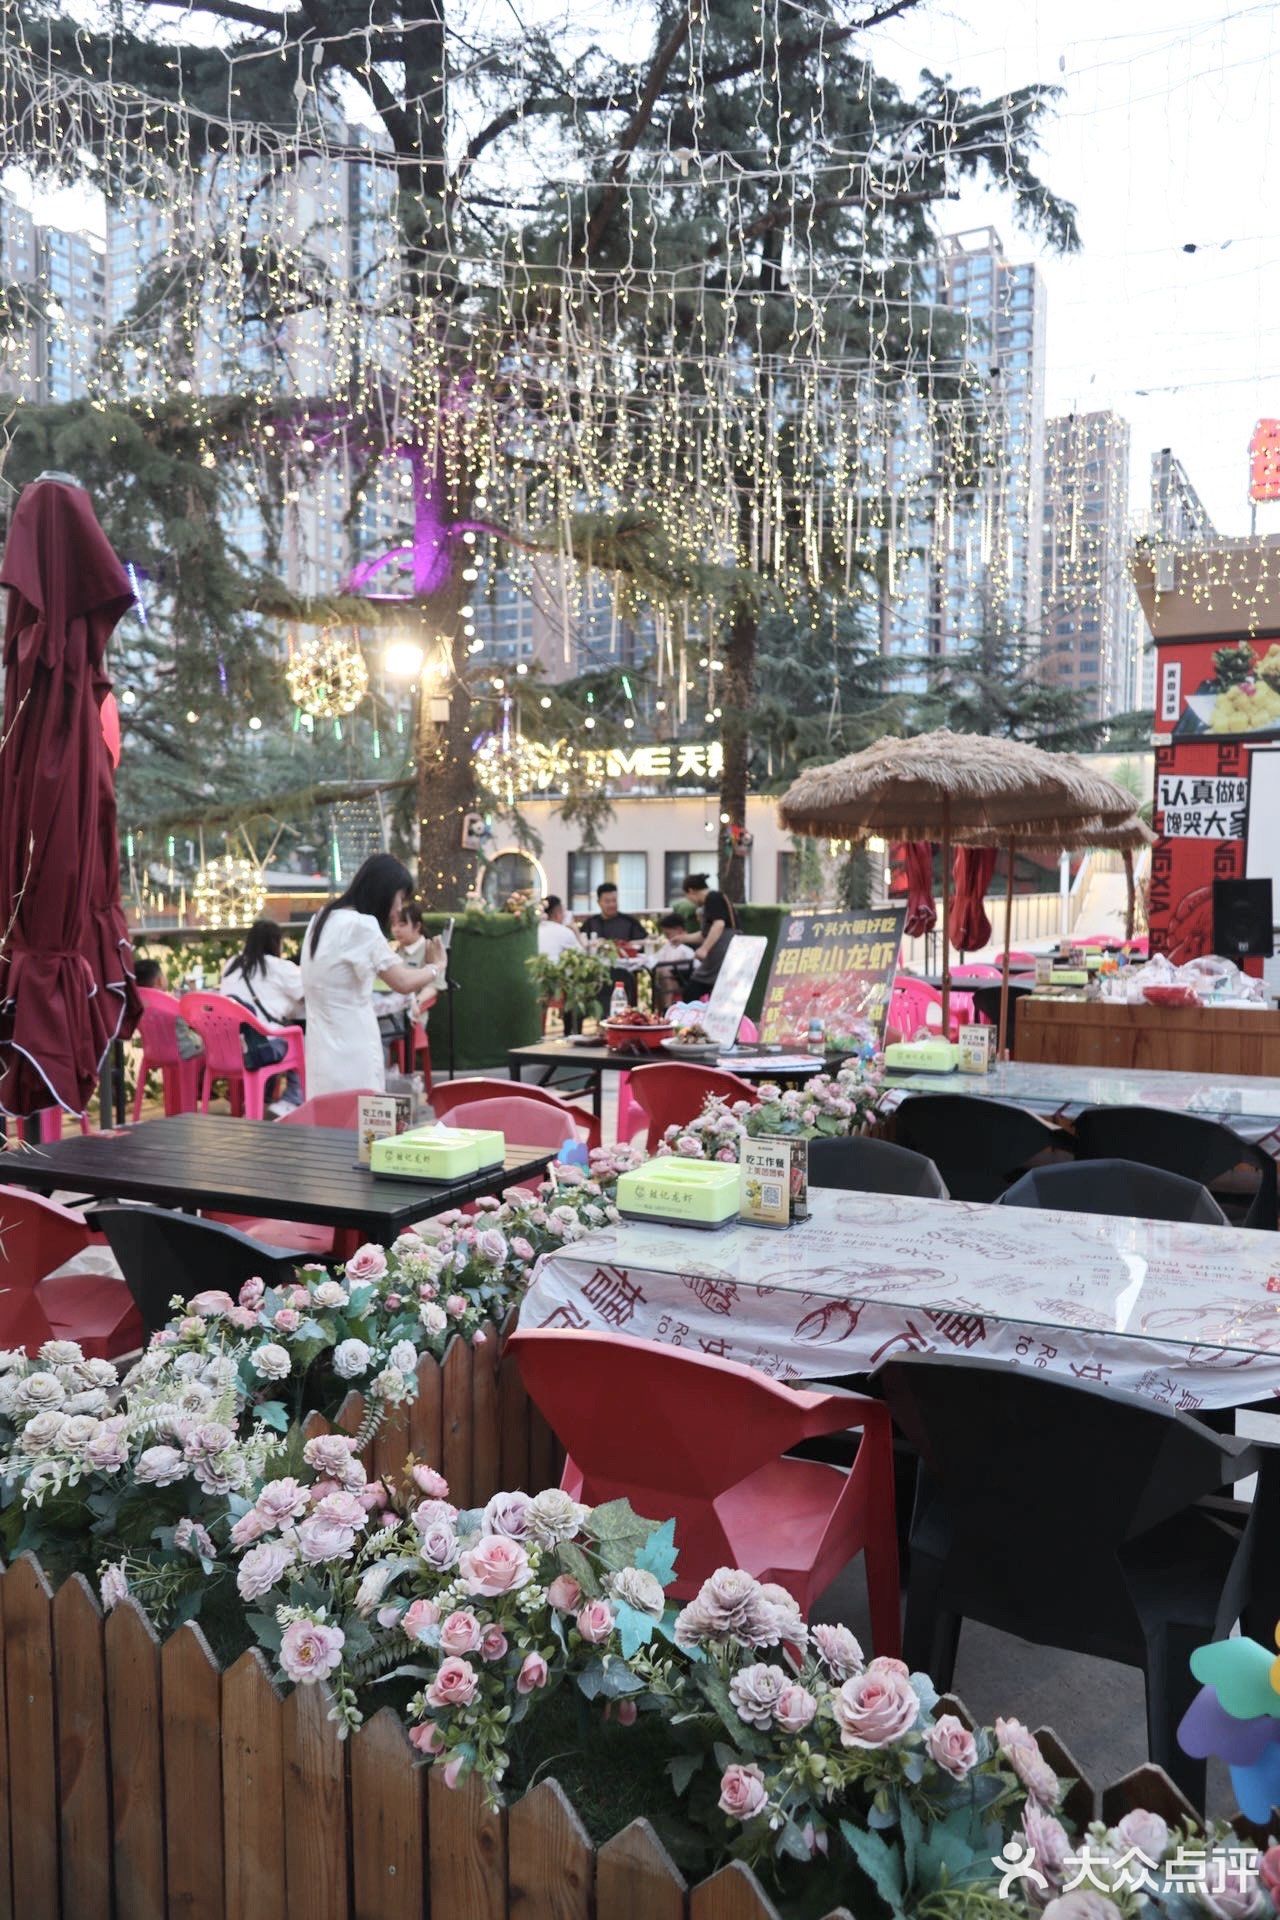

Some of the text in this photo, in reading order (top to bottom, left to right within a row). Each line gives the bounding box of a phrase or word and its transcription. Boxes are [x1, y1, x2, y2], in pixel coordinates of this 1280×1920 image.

[775, 942, 896, 976] 招牌小龙虾
[746, 1154, 784, 1168] 吃工作餐
